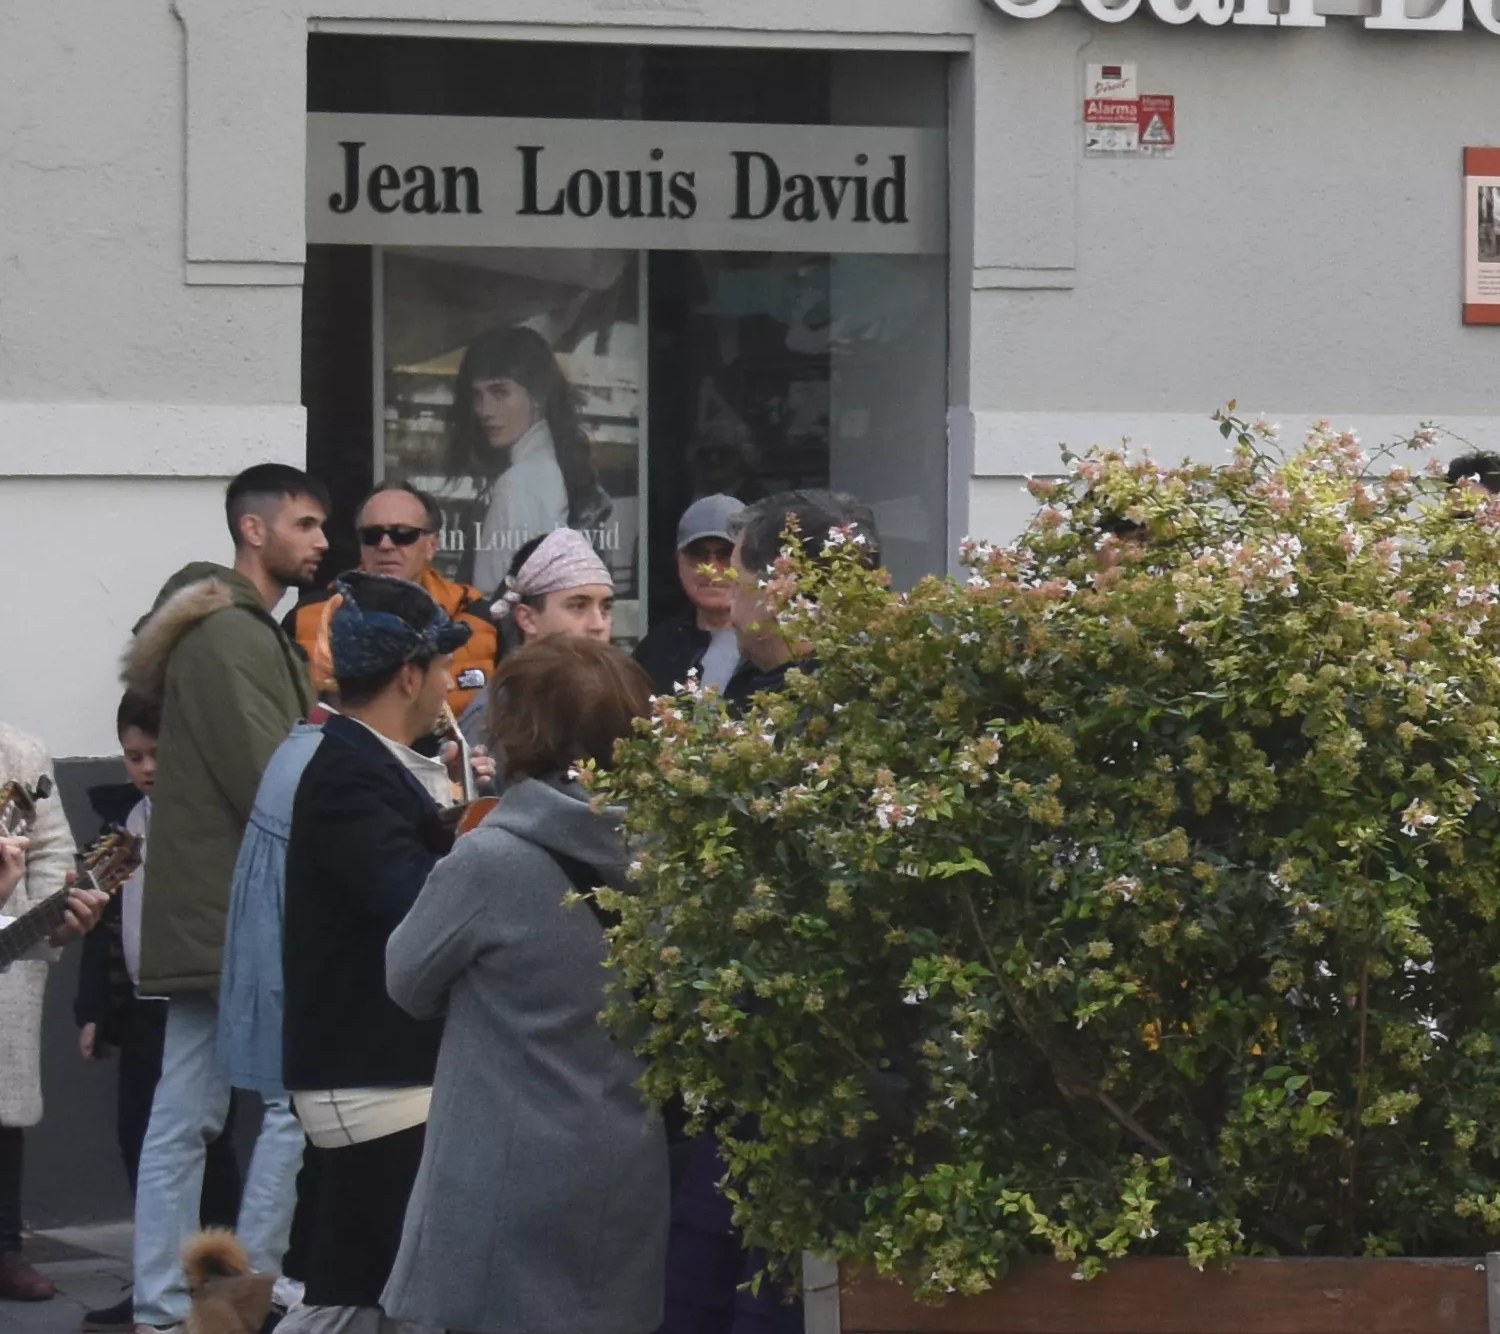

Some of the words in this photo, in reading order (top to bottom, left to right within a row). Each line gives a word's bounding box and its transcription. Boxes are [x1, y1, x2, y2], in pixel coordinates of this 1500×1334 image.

[1087, 101, 1138, 116] Alarma
[328, 141, 483, 215] Jean
[516, 145, 698, 219] Louis
[730, 150, 909, 224] David
